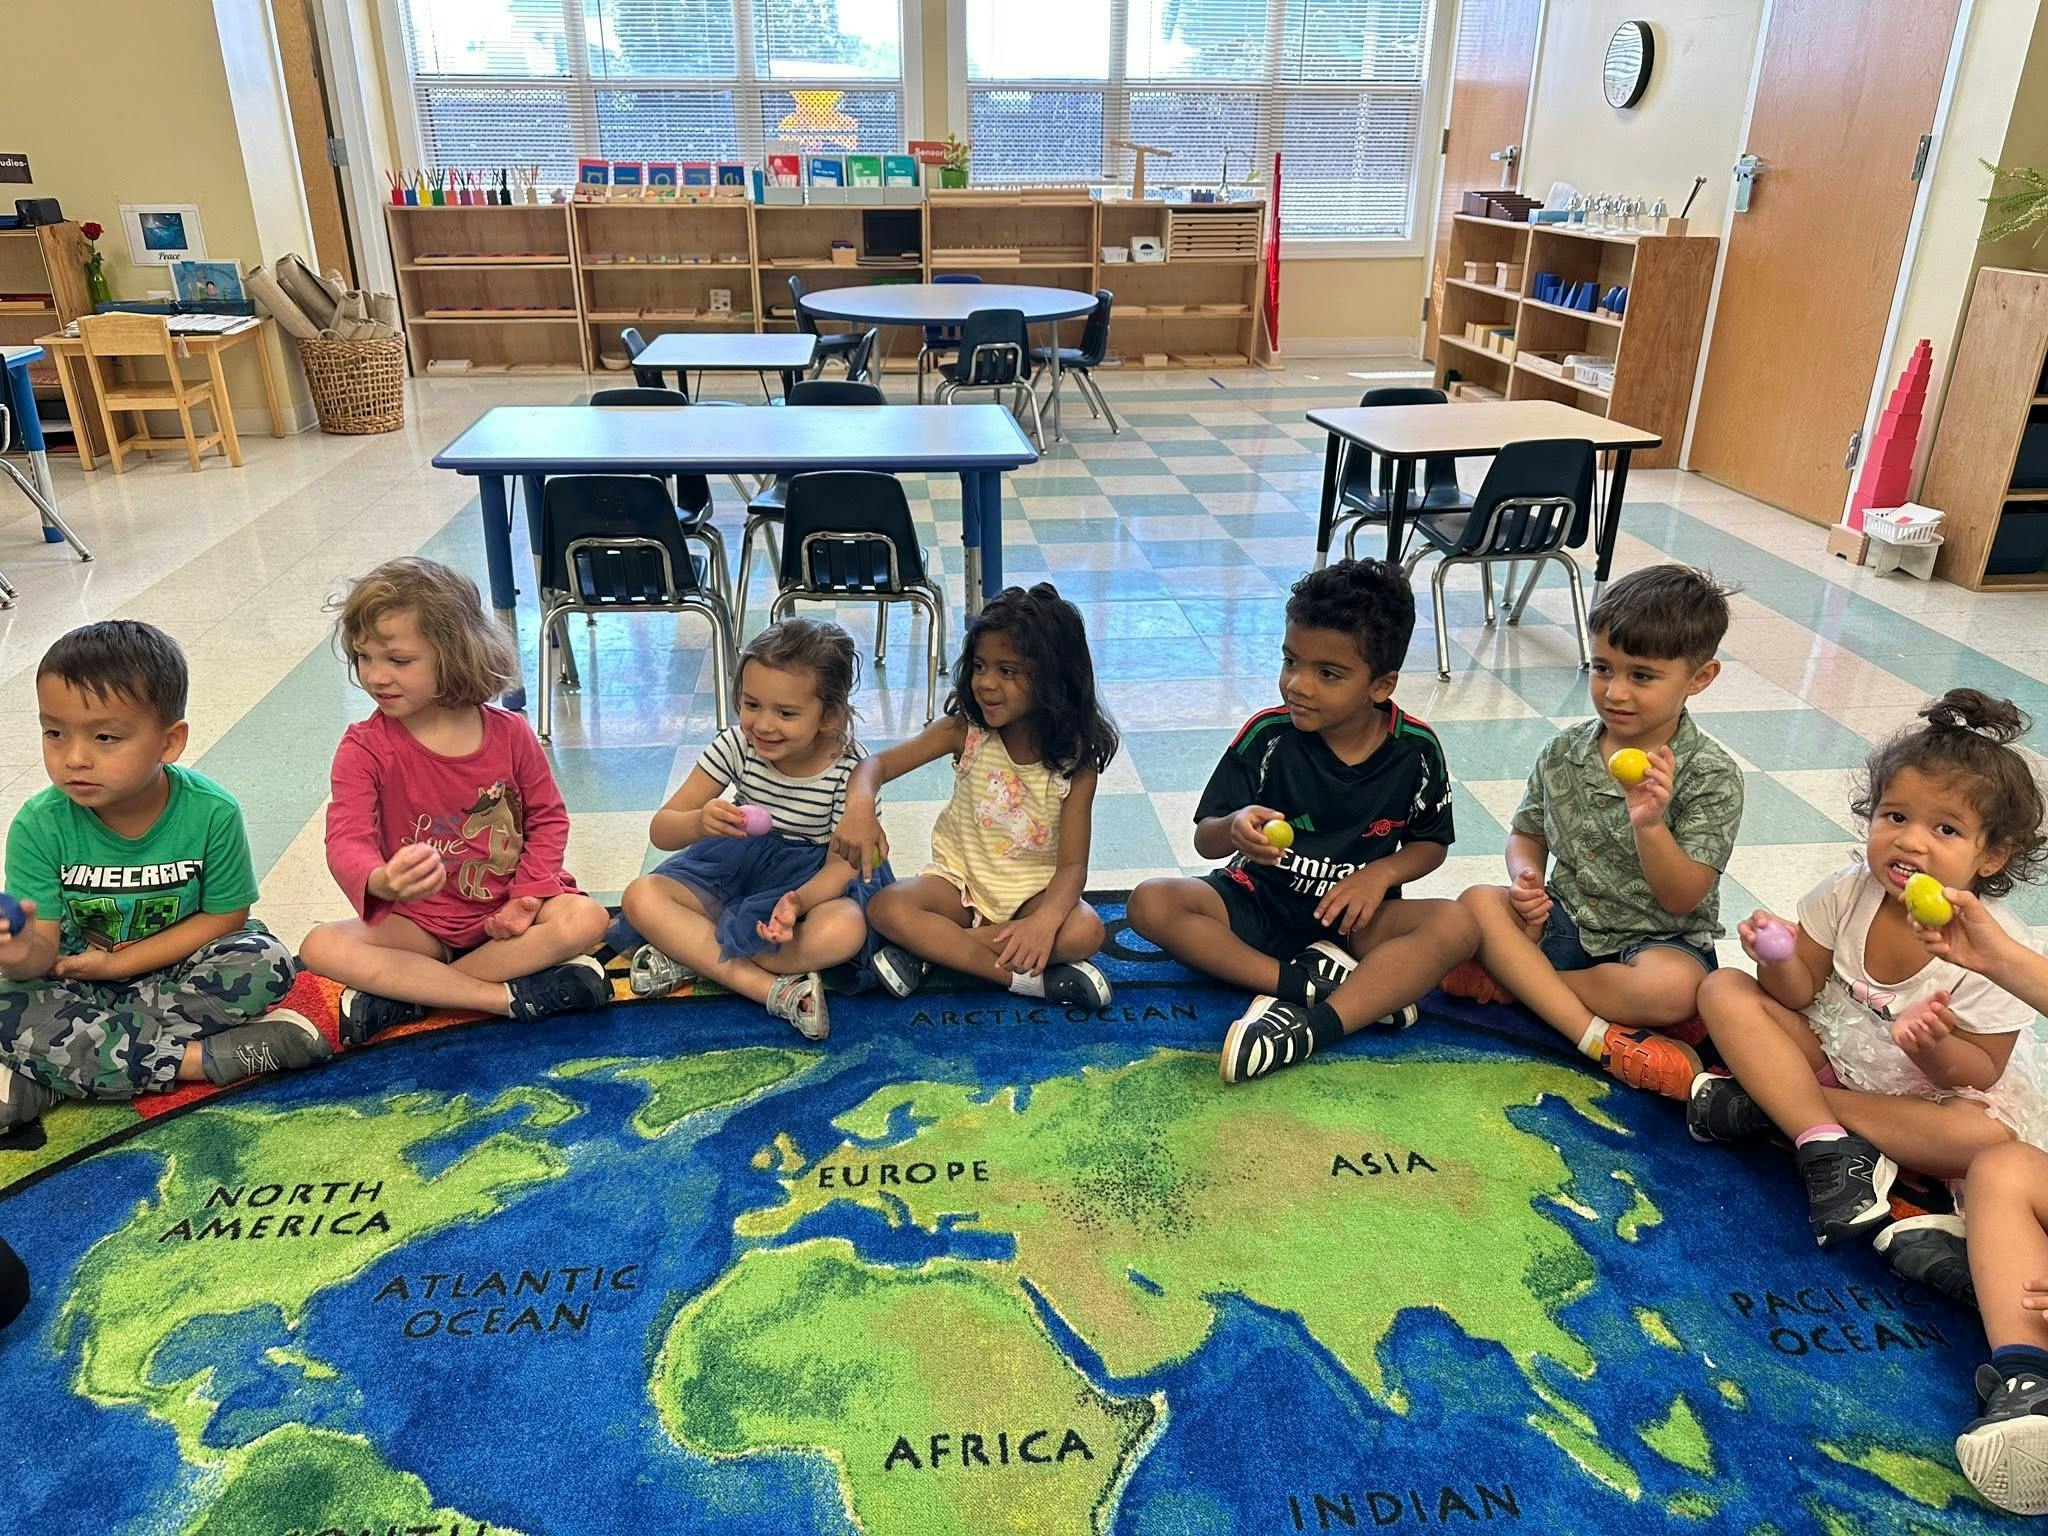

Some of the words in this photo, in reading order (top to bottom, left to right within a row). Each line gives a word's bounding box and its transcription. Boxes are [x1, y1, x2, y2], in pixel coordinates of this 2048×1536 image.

[158, 251, 181, 260] Peace
[909, 1006, 1050, 1027] ARCTIC
[1066, 1002, 1198, 1023] OCEAN
[818, 1160, 990, 1189] EUROPE
[1331, 1150, 1438, 1177] ASIA
[204, 1181, 384, 1209] NORTH
[157, 1210, 391, 1243] AMERICA
[372, 1264, 639, 1305] ATLANTIC
[1729, 1282, 1937, 1317] PACIFIC
[403, 1303, 591, 1340] OCEAN
[1769, 1320, 1954, 1356] OCEAN
[884, 1428, 1095, 1471] AFRICA
[1287, 1483, 1521, 1532] INDIAN
